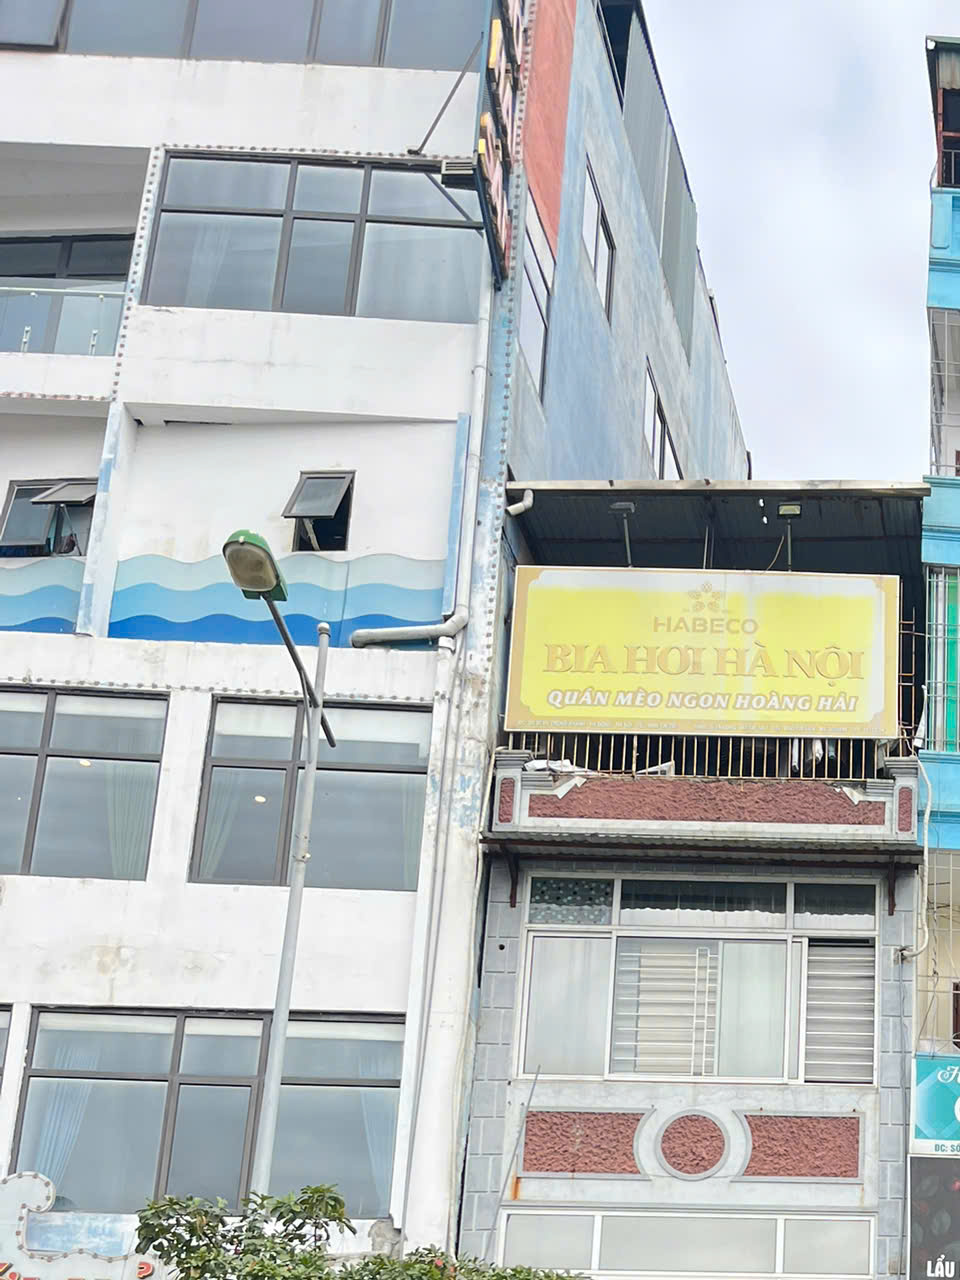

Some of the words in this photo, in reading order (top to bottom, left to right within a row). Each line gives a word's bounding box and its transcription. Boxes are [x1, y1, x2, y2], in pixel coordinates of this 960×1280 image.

[653, 615, 759, 634] HABECO
[542, 643, 617, 674] BIA
[713, 640, 779, 677] HÀ
[782, 645, 865, 687] NỘI
[547, 687, 609, 709] QUÁN
[614, 687, 662, 708] MÈO
[666, 691, 730, 709] NGON
[734, 691, 811, 711] HOÀNG
[816, 691, 859, 712] HẢI
[927, 1254, 955, 1279] LẨU
